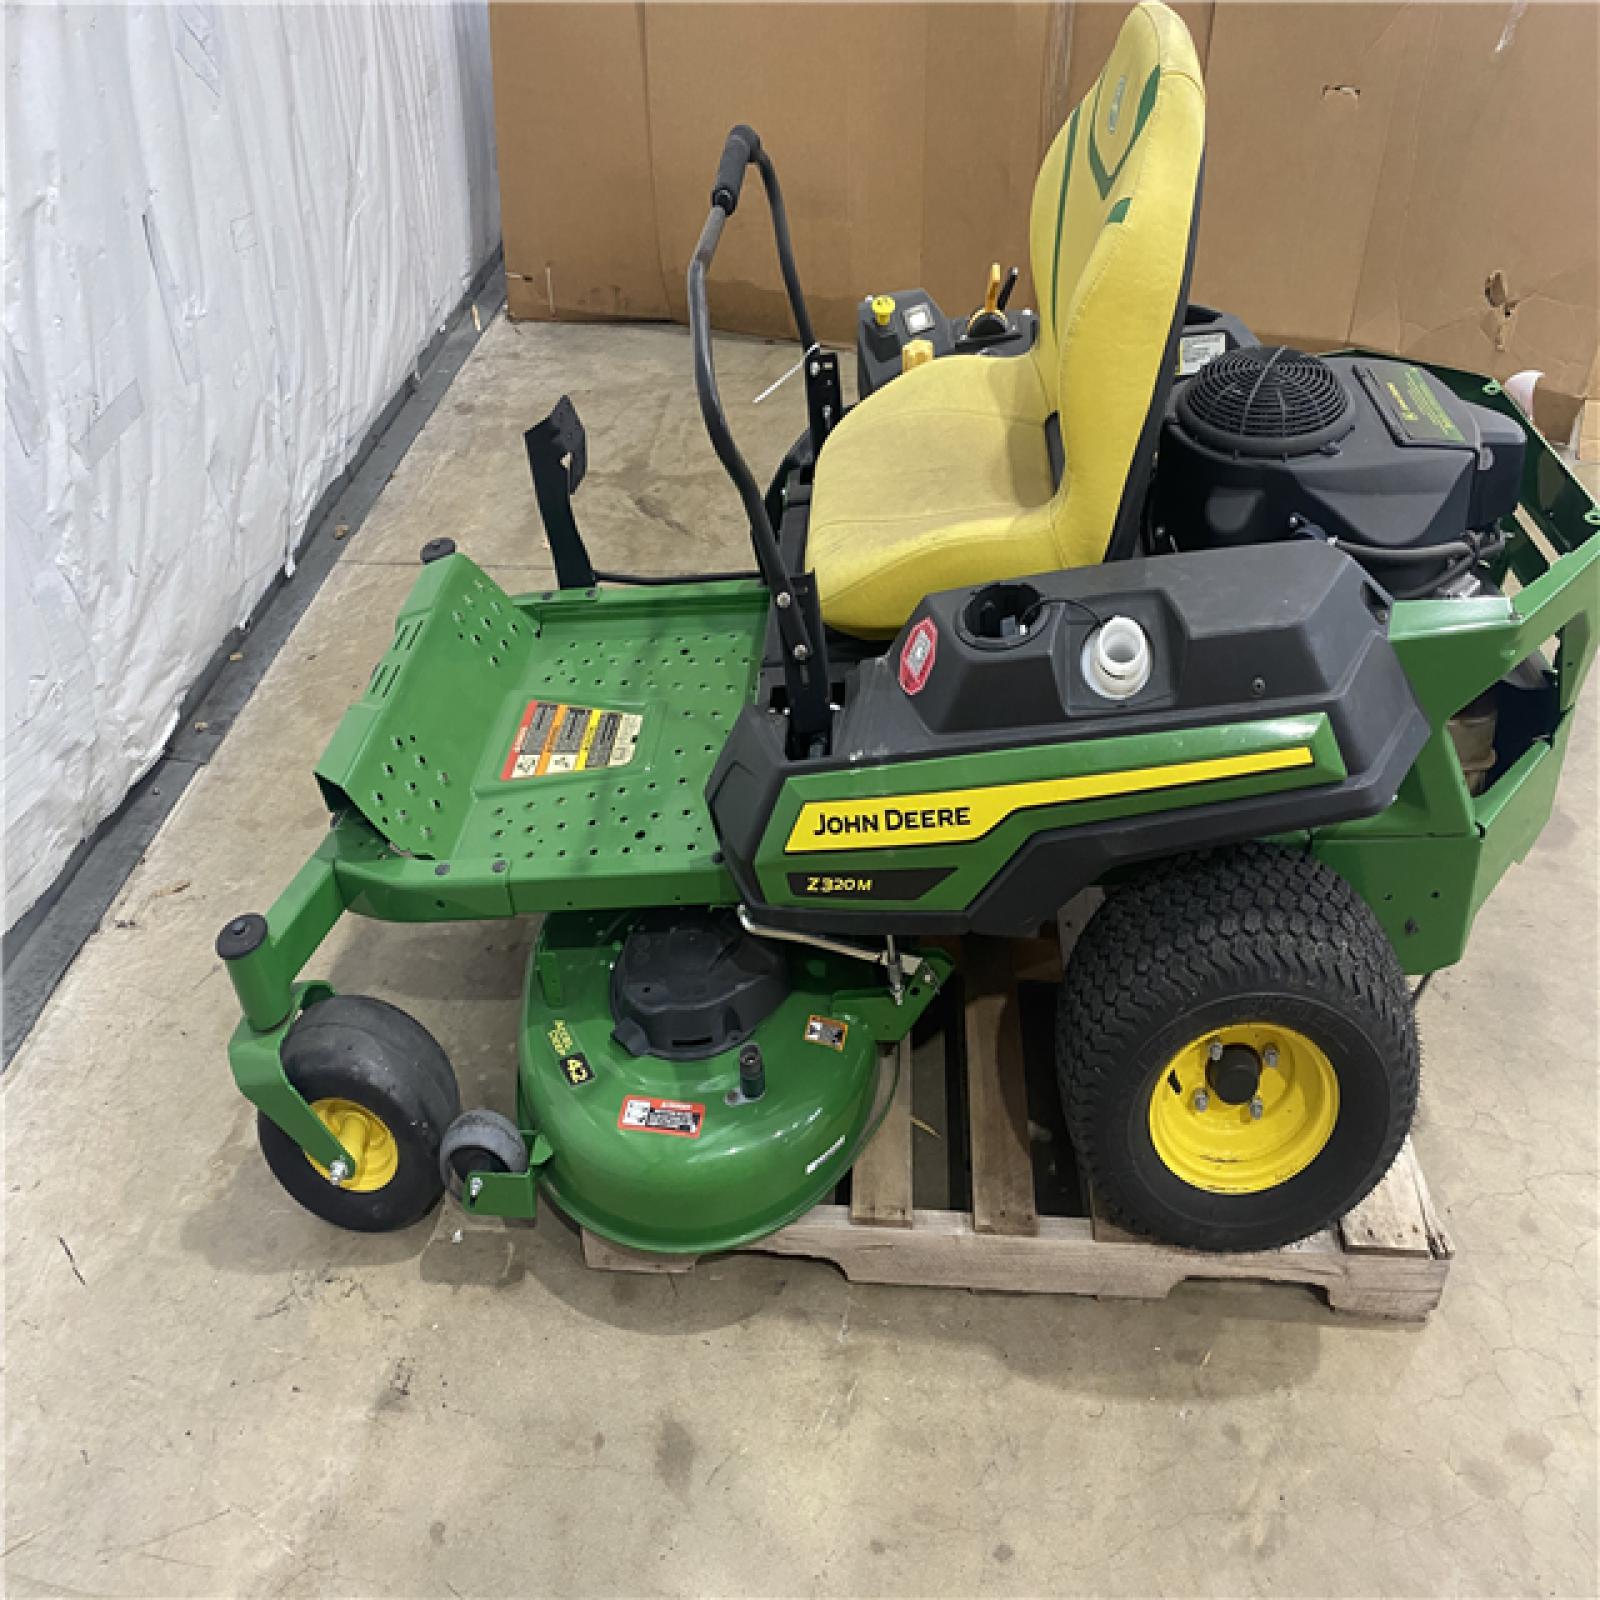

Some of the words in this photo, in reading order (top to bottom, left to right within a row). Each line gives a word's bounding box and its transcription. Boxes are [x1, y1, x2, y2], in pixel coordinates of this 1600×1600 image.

[814, 812, 879, 836] JOHN
[884, 807, 971, 831] DEERE
[566, 1059, 588, 1083] 42
